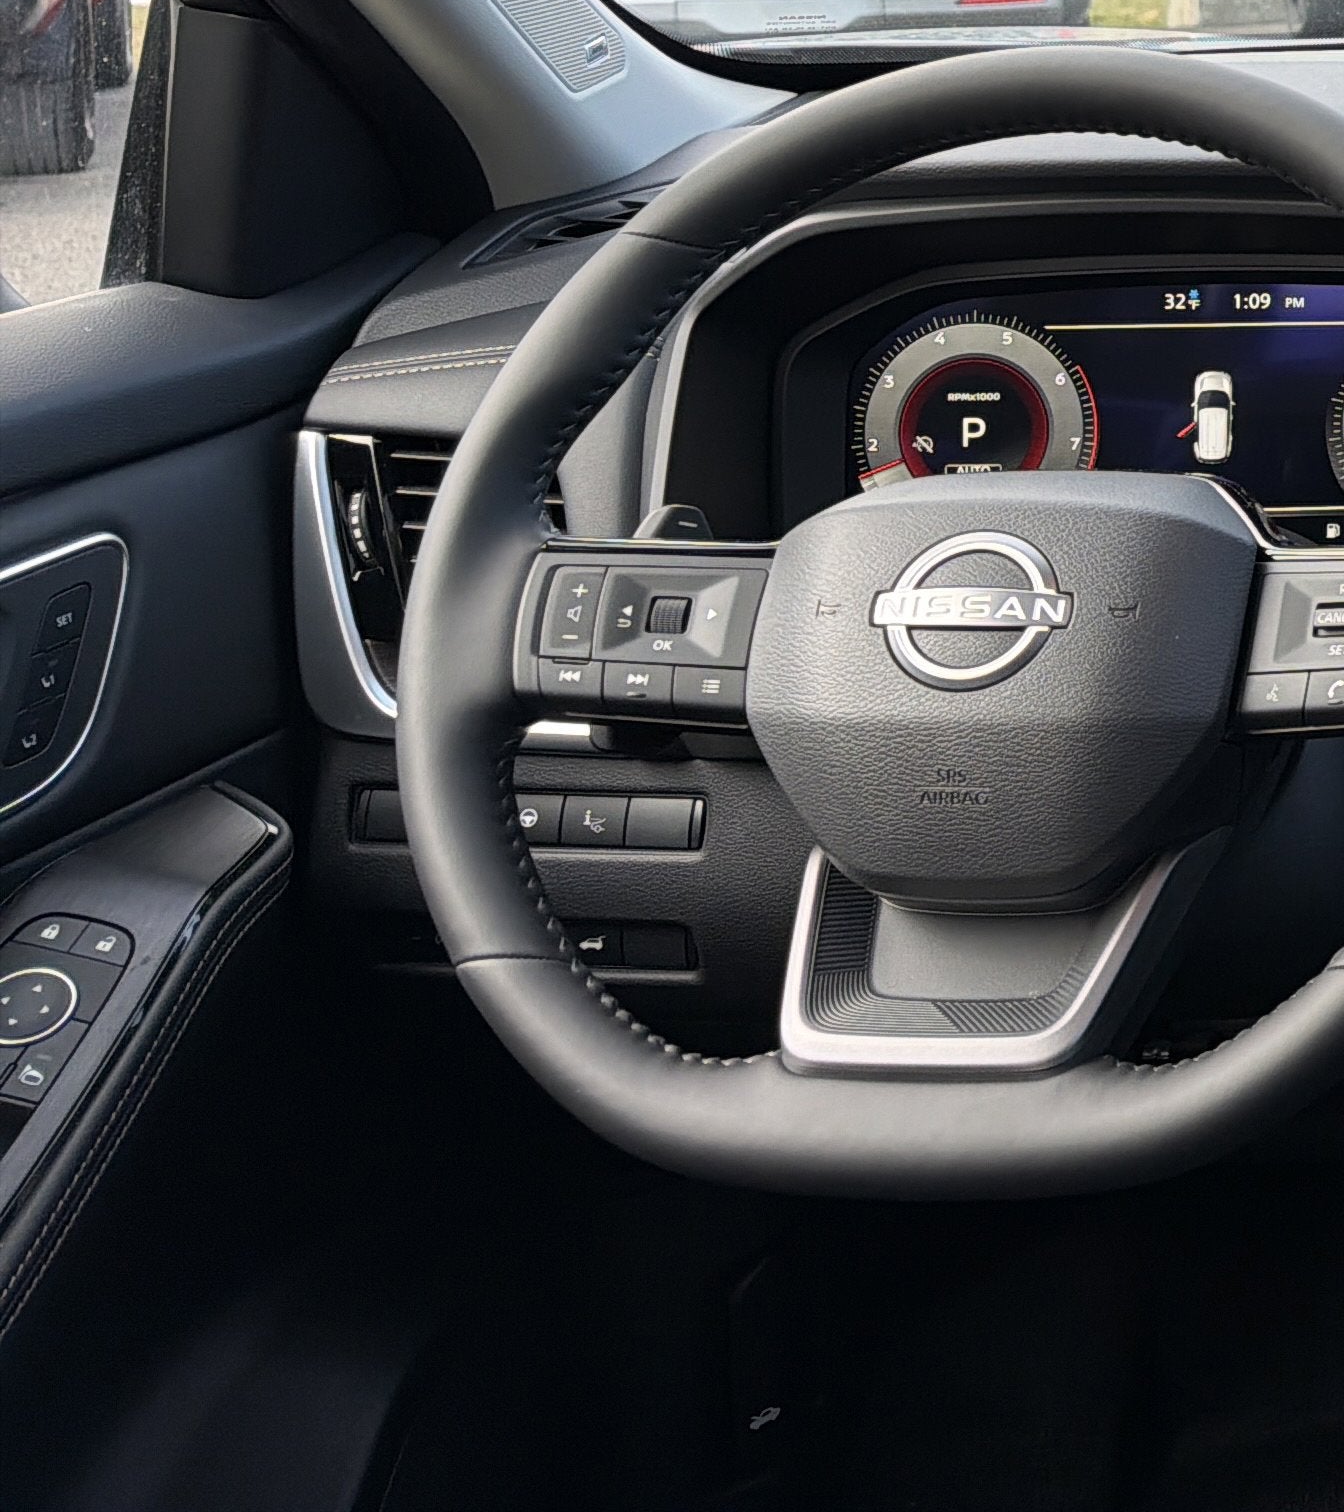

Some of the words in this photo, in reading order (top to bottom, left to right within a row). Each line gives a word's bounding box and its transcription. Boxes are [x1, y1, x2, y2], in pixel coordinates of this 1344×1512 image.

[1233, 293, 1271, 310] 1:09
[1285, 297, 1305, 308] PM
[934, 332, 945, 345] 4
[1002, 331, 1013, 345] 5
[884, 375, 895, 388] 3
[1055, 373, 1066, 386] 6
[962, 417, 987, 448] P
[867, 438, 879, 452] 2
[1069, 437, 1081, 450] 7
[878, 591, 1067, 624] NISSAN
[56, 613, 73, 627] SET
[652, 639, 673, 652] OK
[935, 768, 967, 785] SRS
[919, 790, 990, 807] AIRBAG
